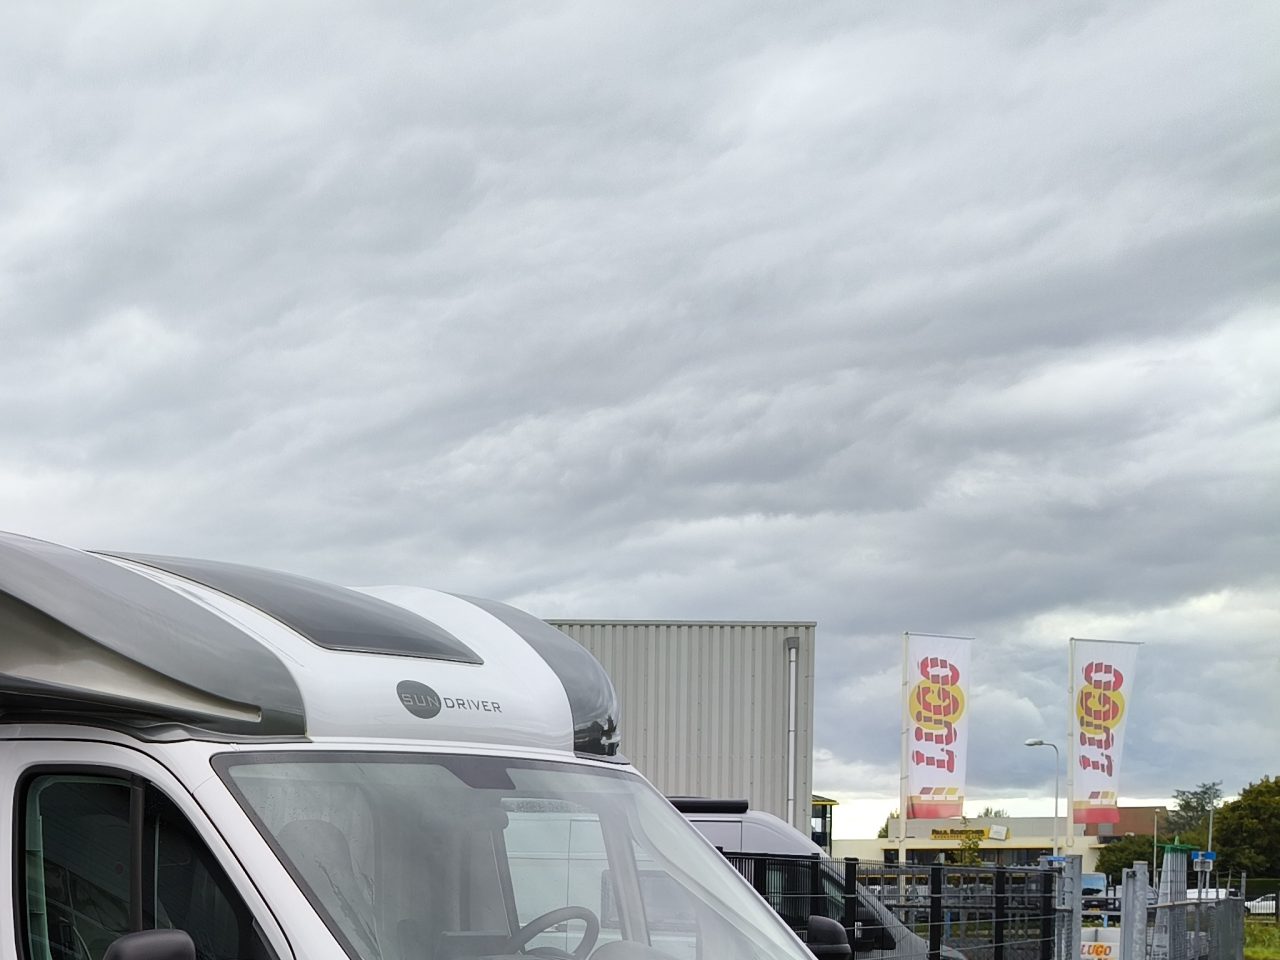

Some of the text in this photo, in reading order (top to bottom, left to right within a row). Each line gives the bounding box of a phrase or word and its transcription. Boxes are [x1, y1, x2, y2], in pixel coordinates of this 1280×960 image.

[401, 693, 502, 713] SUN DRIVER
[1081, 944, 1112, 956] LUGO
